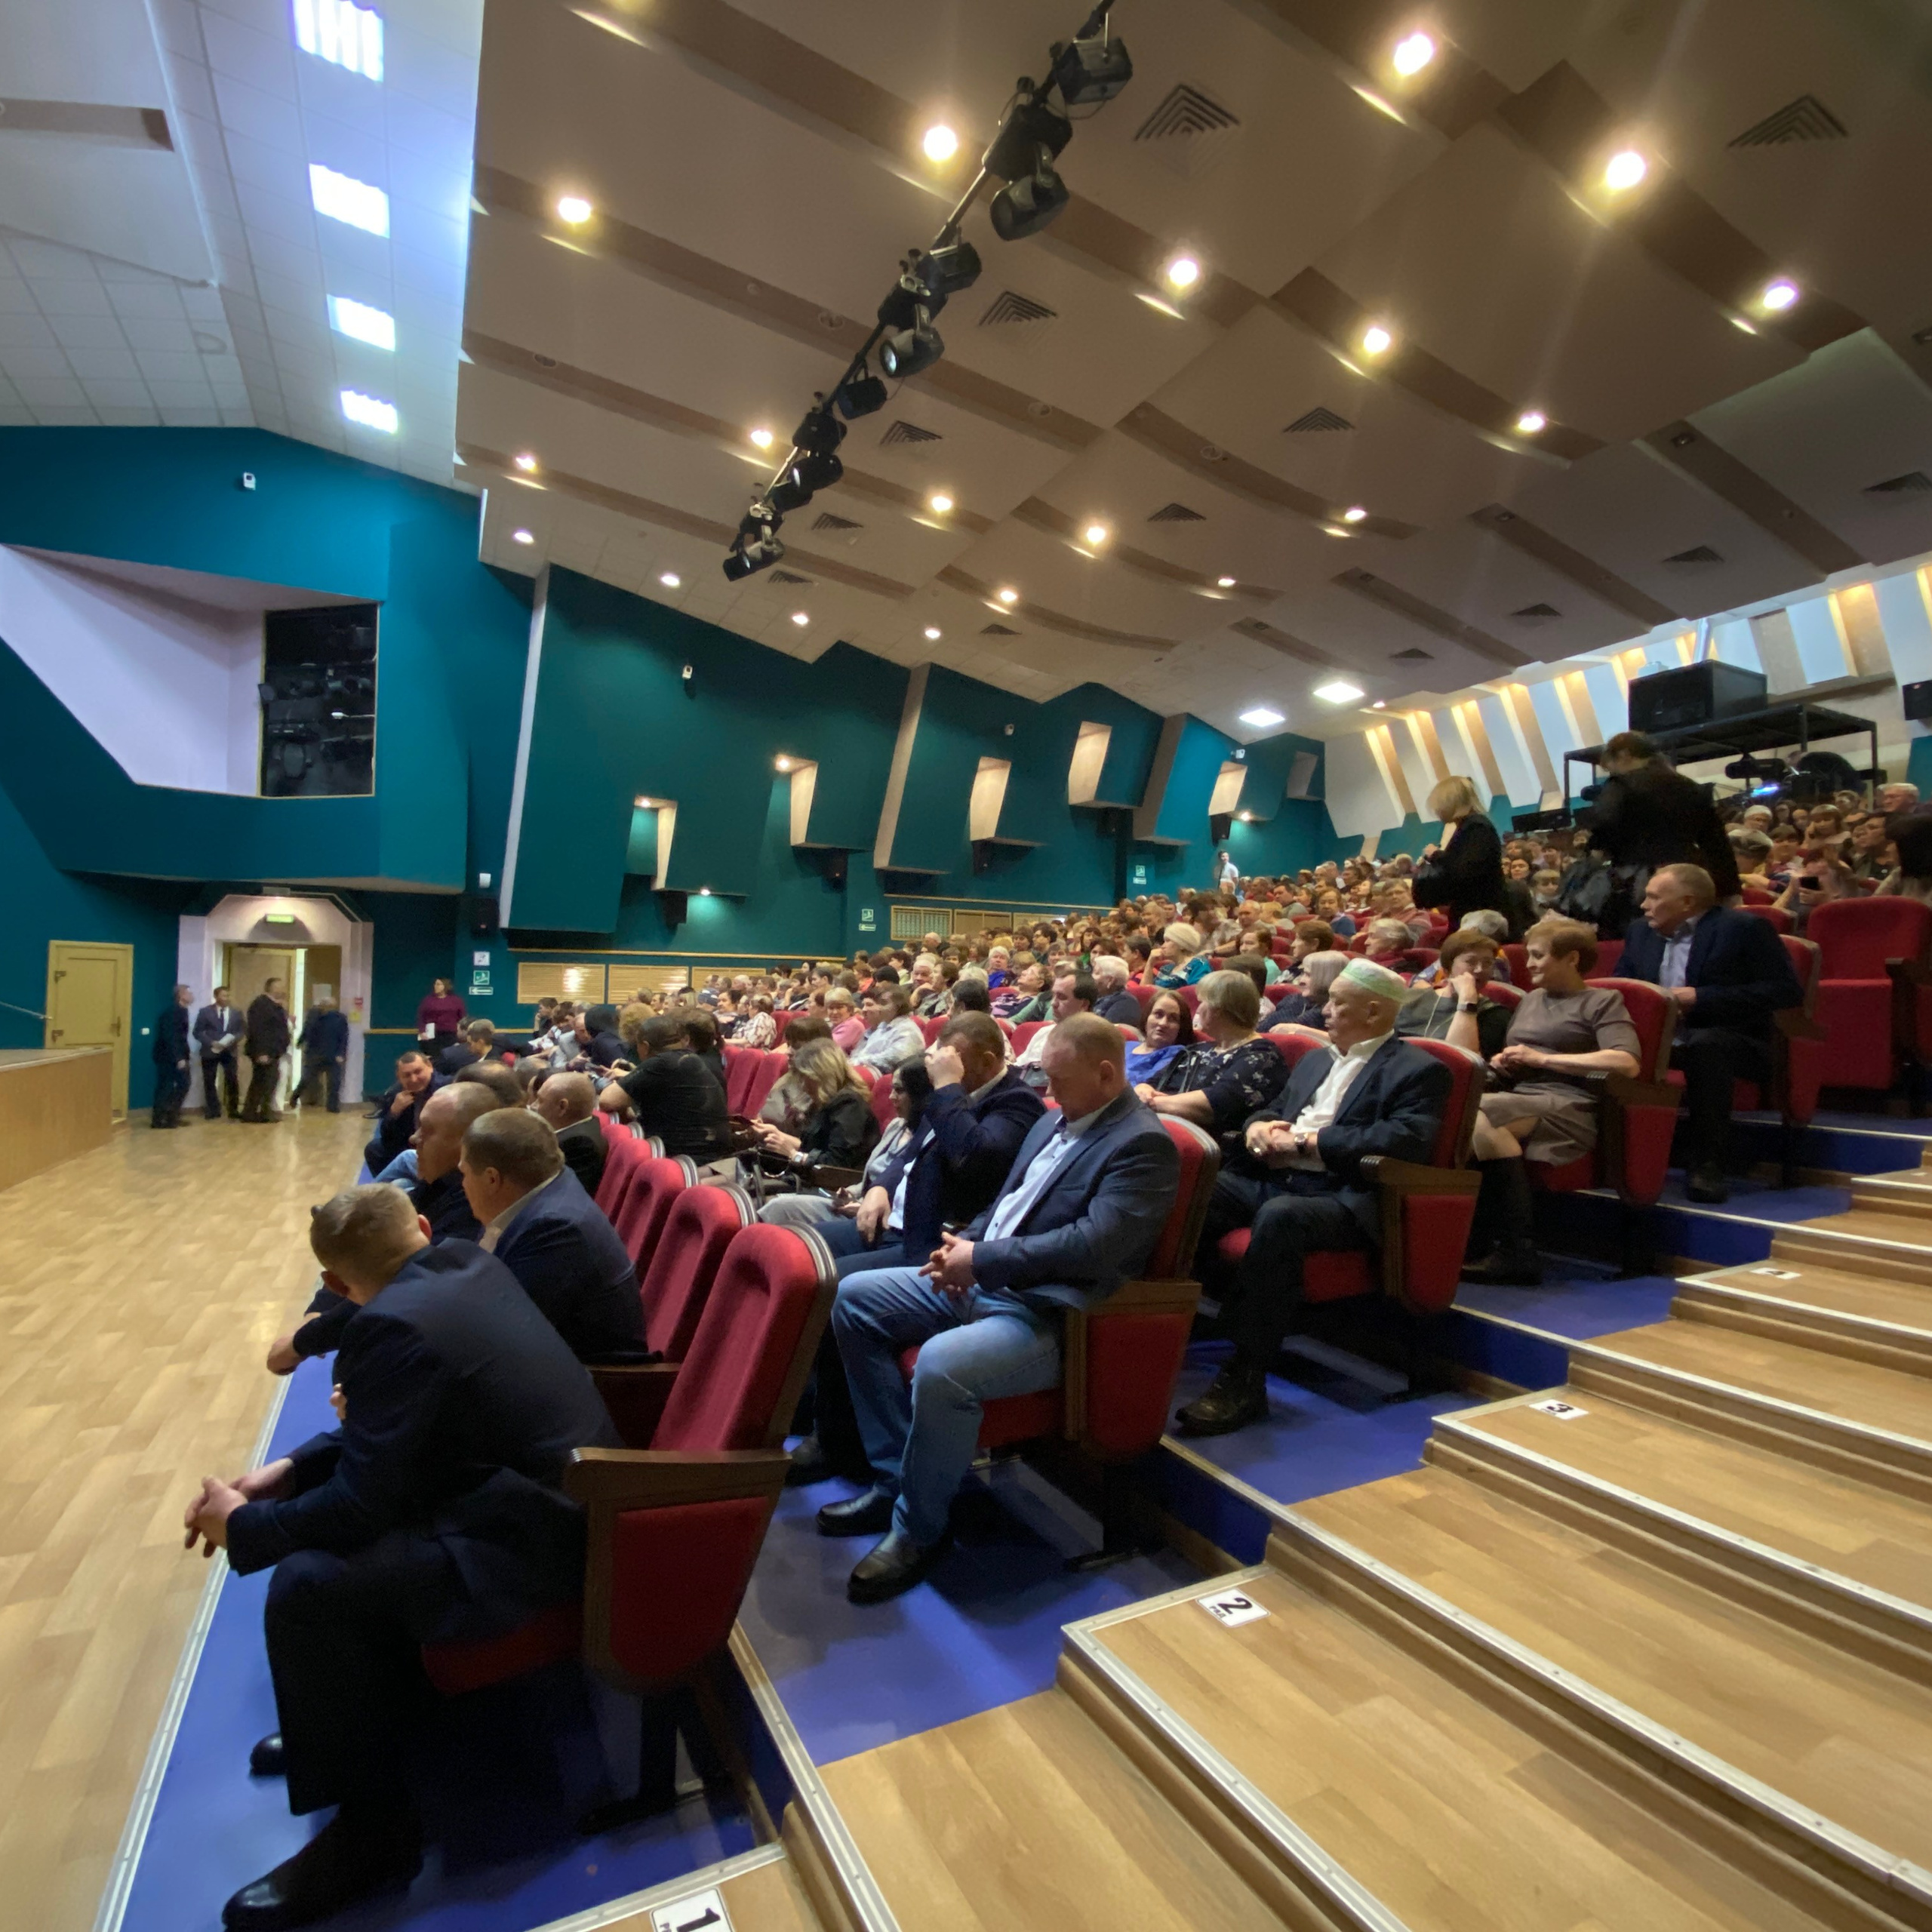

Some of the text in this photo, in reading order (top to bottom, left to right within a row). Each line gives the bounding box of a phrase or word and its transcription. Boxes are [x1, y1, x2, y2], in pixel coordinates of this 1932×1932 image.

[1546, 1404, 1574, 1412] 3
[1217, 1598, 1253, 1614] 2
[676, 1907, 721, 1932] 1
